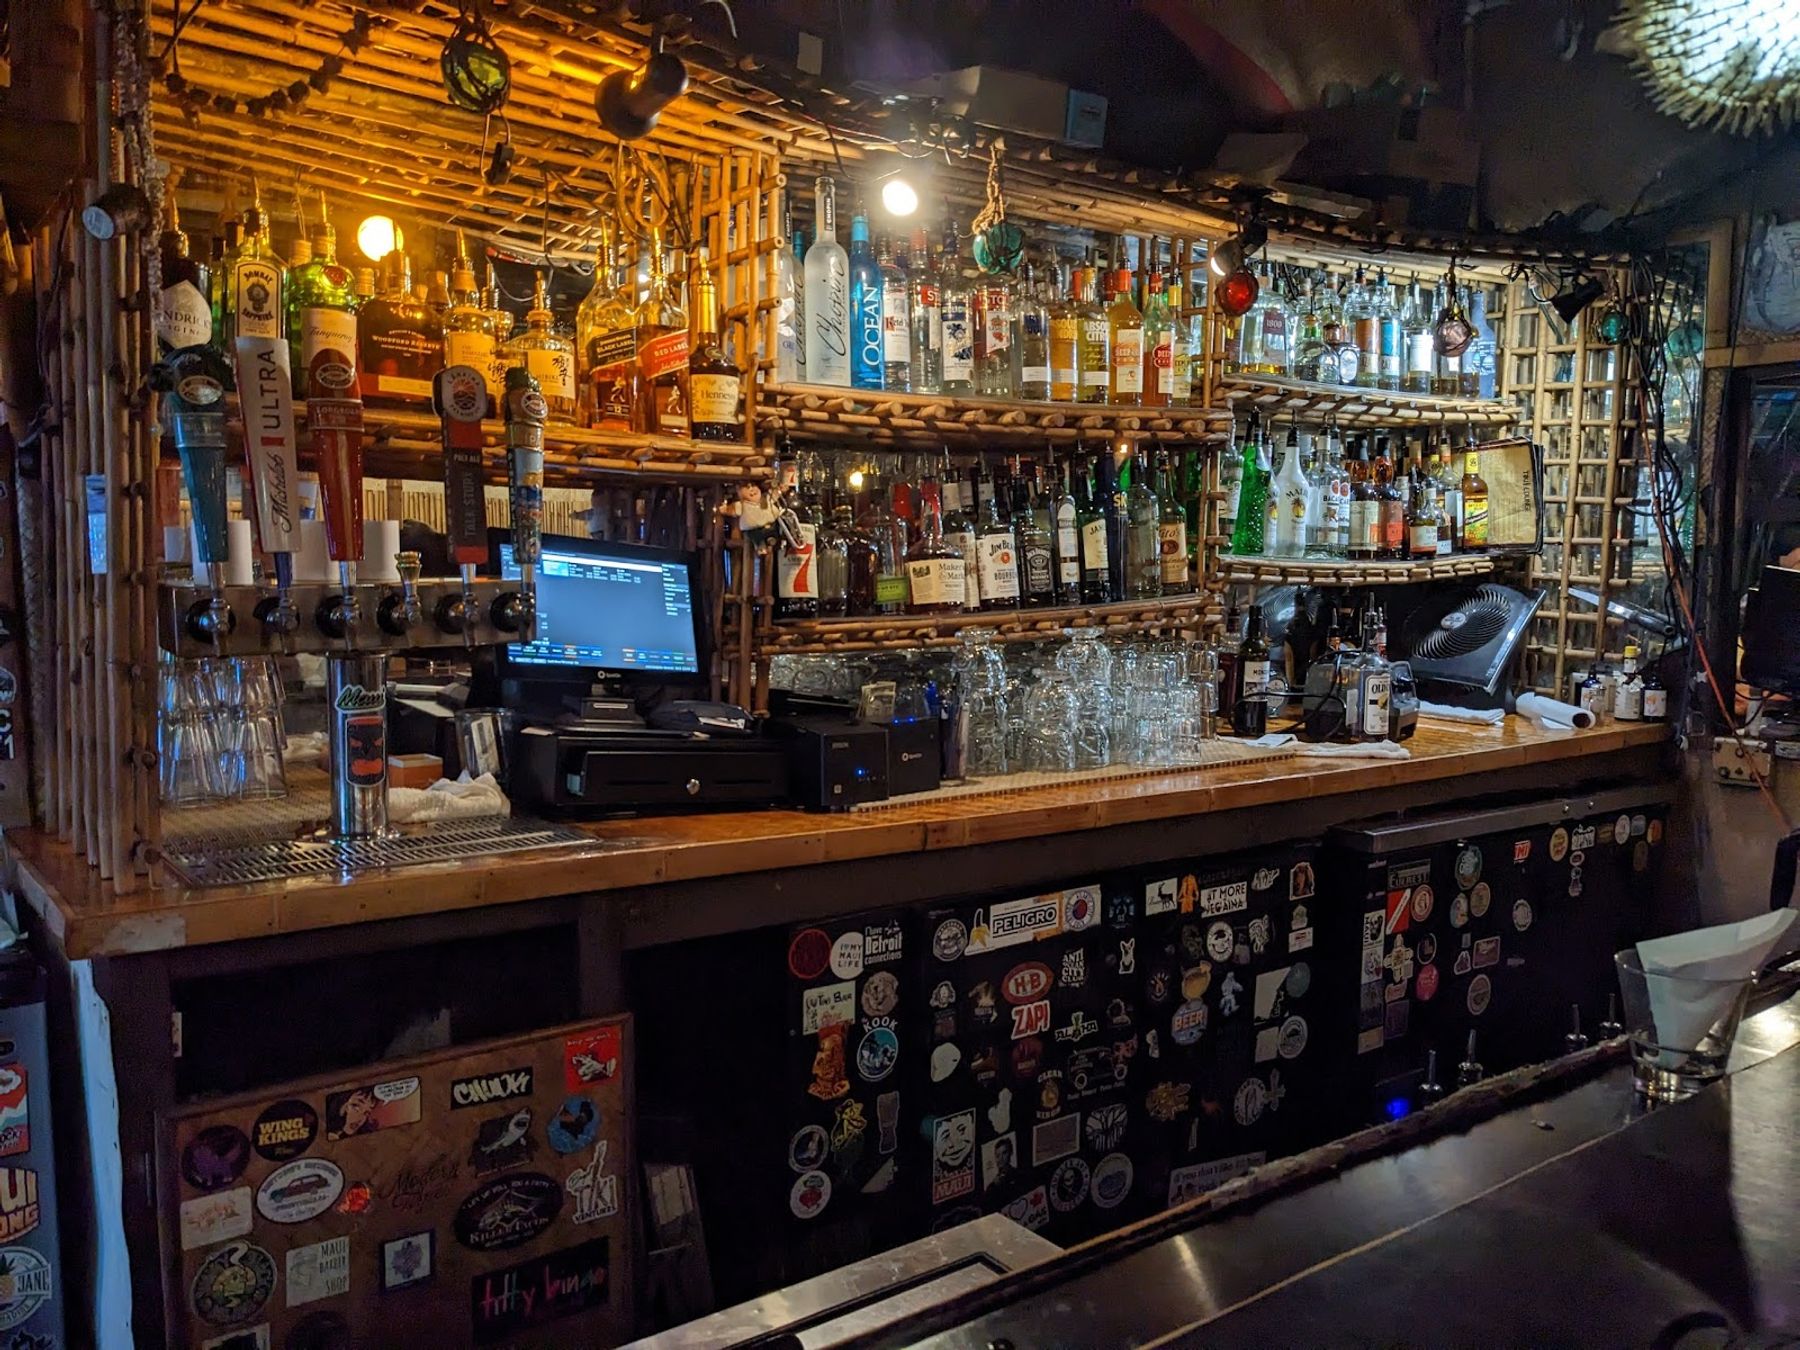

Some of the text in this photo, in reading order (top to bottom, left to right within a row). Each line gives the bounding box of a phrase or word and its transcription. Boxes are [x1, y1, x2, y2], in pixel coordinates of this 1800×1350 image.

[243, 271, 273, 284] BOMBAY
[241, 308, 274, 321] SAPPHIRE
[816, 262, 846, 356] Chopin
[862, 286, 880, 366] OCEAN
[372, 335, 410, 345] WOODFORD
[596, 340, 635, 353] BLACK LABEL
[654, 347, 669, 357] RED
[258, 349, 281, 430] ULTRA
[266, 452, 293, 534] Michelob
[989, 541, 1001, 557] JIM
[784, 543, 814, 593] 7
[994, 572, 1017, 582] BOURBO
[1220, 883, 1246, 898] MORE
[993, 906, 1057, 934] PELIGRO
[1062, 948, 1084, 962] ANTI
[259, 1117, 304, 1134] WING
[258, 1128, 310, 1147] KINGS
[936, 1175, 973, 1198] MAUI
[321, 1239, 346, 1257] MAUI
